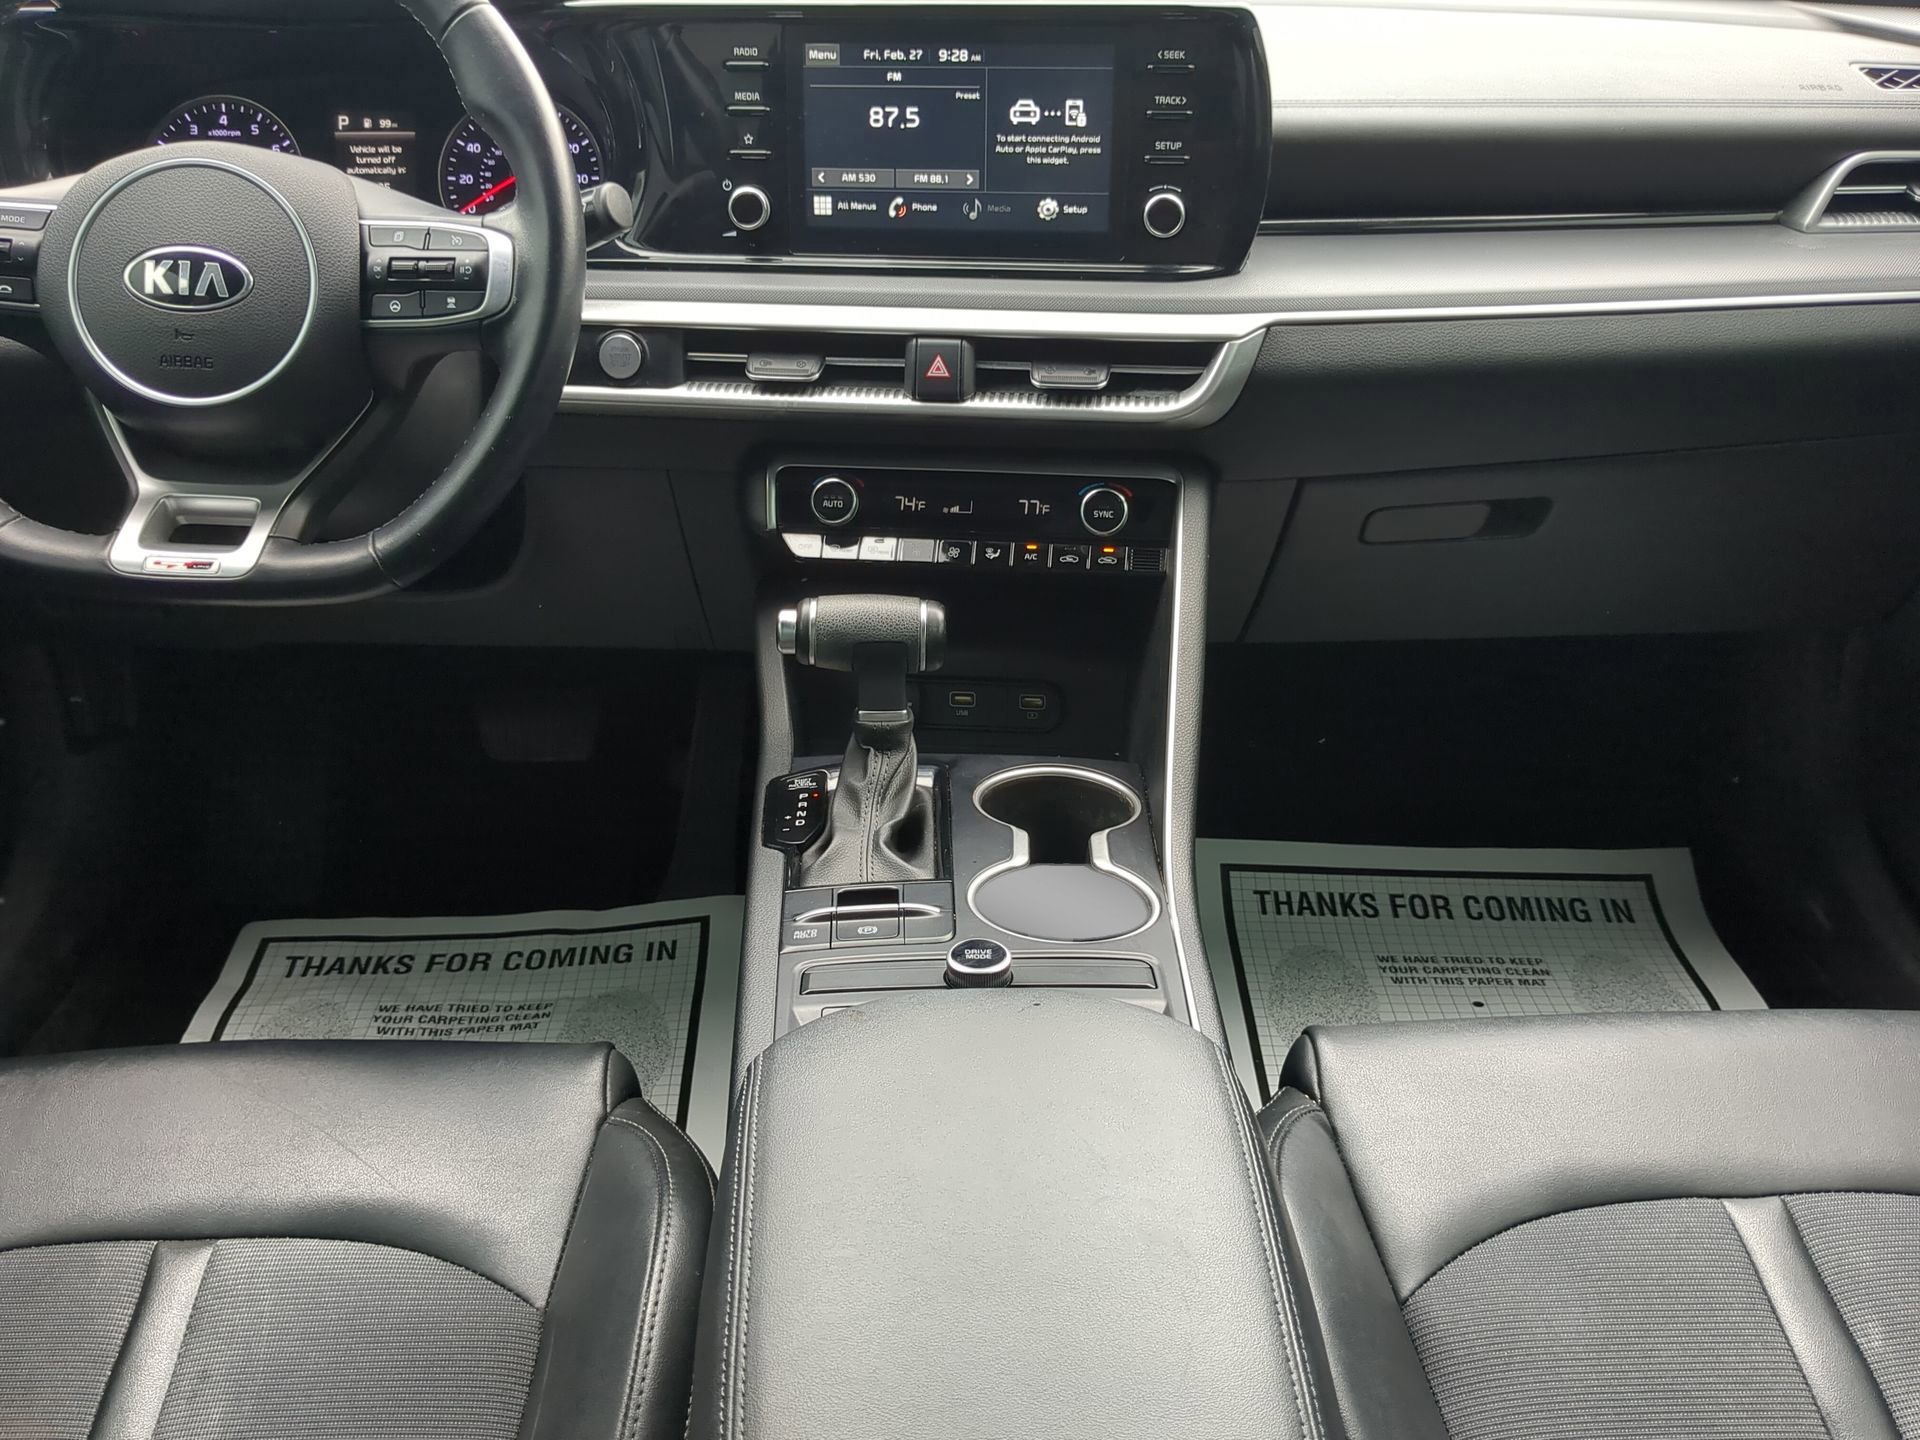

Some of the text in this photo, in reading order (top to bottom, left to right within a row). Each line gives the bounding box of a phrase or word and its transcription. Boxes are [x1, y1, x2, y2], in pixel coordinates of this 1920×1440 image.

[733, 47, 758, 56] RADIO
[808, 50, 837, 60] Menu
[909, 50, 923, 60] 27
[938, 49, 981, 62] 9:28 AM
[1163, 50, 1185, 60] SEEK
[887, 72, 902, 82] FM
[734, 92, 760, 101] MEDIA
[955, 92, 981, 100] Preset
[1154, 96, 1181, 105] TRACK
[219, 115, 229, 126] 4
[338, 115, 349, 130] P
[869, 106, 920, 129] 87.5
[190, 125, 199, 135] 3
[250, 125, 260, 135] 5
[996, 134, 1101, 144] To start connecting Android
[349, 145, 402, 153] Vehicle will be
[466, 143, 482, 153] 40
[995, 145, 1014, 153] Auto
[1025, 146, 1047, 155] Apple
[1079, 147, 1102, 155] press
[1155, 141, 1182, 150] SETUP
[356, 156, 381, 164] turned
[1026, 156, 1041, 164] this
[346, 167, 397, 175] automatically
[459, 174, 474, 184] 20
[841, 174, 876, 183] AM 530
[914, 174, 949, 185] FM 88.1
[837, 201, 877, 211] All Menus
[912, 203, 938, 212] Phone
[987, 205, 1011, 213] Media
[1063, 205, 1088, 215] Setup
[1, 215, 25, 224] MODE
[143, 260, 229, 298] KIA
[159, 354, 214, 370] AIRBAG
[823, 500, 844, 508] AUTO
[1093, 510, 1115, 519] SYNC
[1024, 553, 1038, 561] A/C
[1253, 890, 1636, 923] THANKS FOR COMING IN
[284, 939, 677, 979] THANKS FOR COMING IN
[1376, 955, 1543, 966] WE HAVE TRIED TO KEEP
[1379, 966, 1550, 976] YOUR CARPETING CLEAN
[1390, 977, 1547, 987] WITH THIS PAPER MAT
[378, 1003, 553, 1014] WE HAVE TRIED TO KEEP
[373, 1011, 551, 1025] YOUR CARPETING CLEAN
[376, 1021, 541, 1037] WITH THIS PAPER MAT
